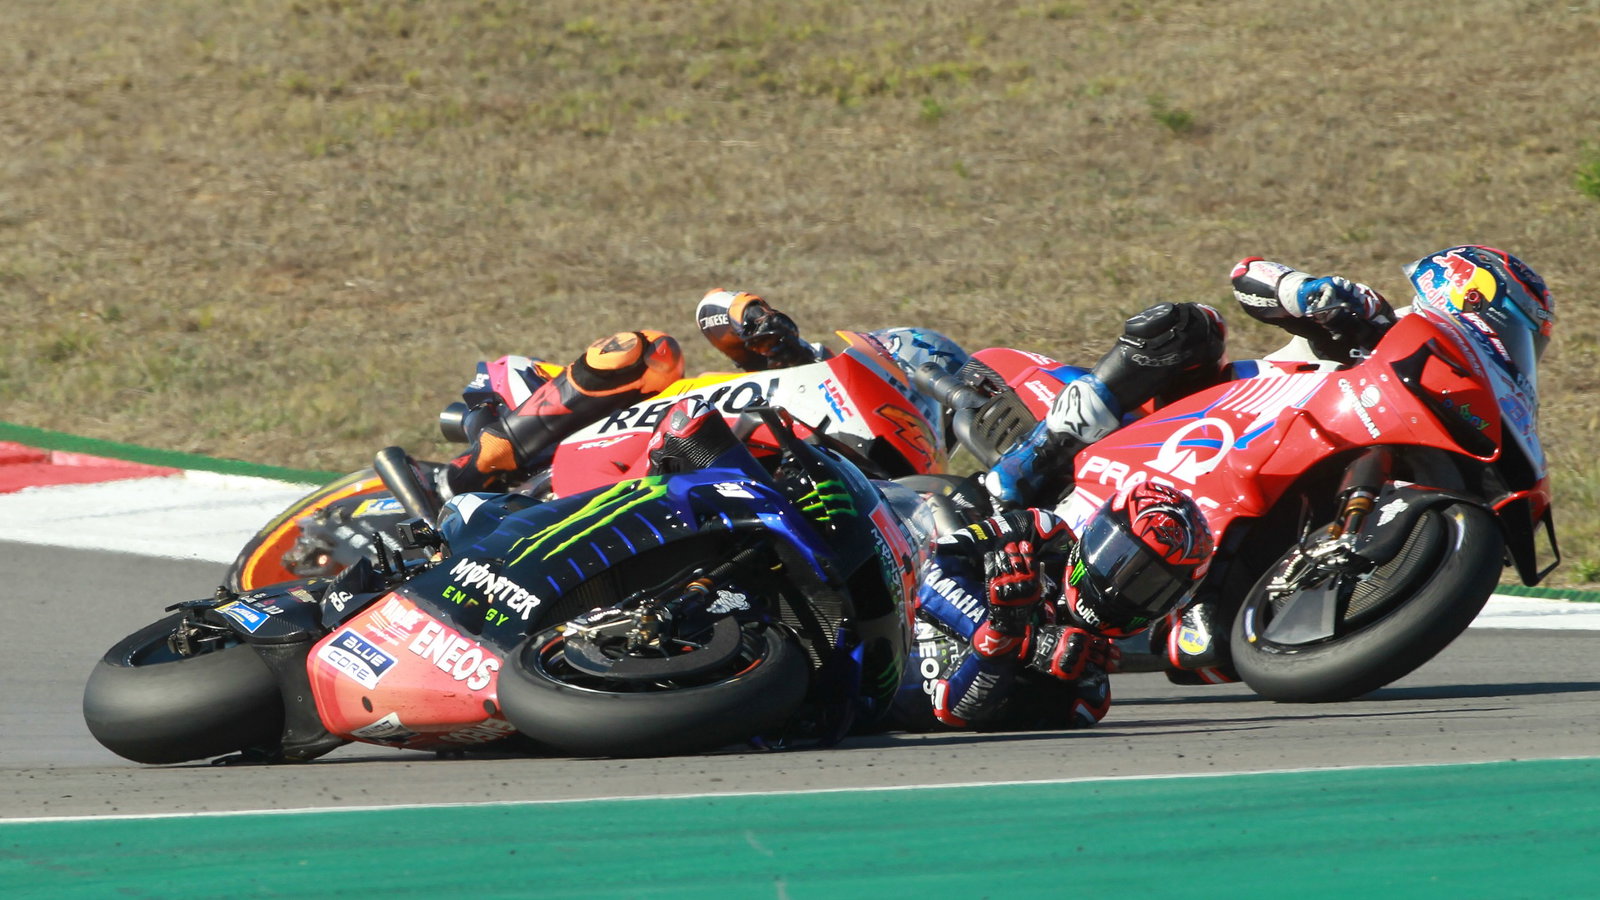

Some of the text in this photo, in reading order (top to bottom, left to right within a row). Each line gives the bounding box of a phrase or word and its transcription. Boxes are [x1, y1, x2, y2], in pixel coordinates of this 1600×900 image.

[598, 378, 780, 434] REO
[818, 378, 854, 422] HRC
[1077, 456, 1220, 509] PRA
[442, 585, 509, 627] ENGY
[449, 557, 541, 620] MONSTER
[920, 558, 986, 624] YAMAHA
[328, 650, 370, 680] CORE
[342, 636, 387, 667] BLUE
[408, 620, 499, 691] ENEOS
[917, 621, 940, 695] NEOS
